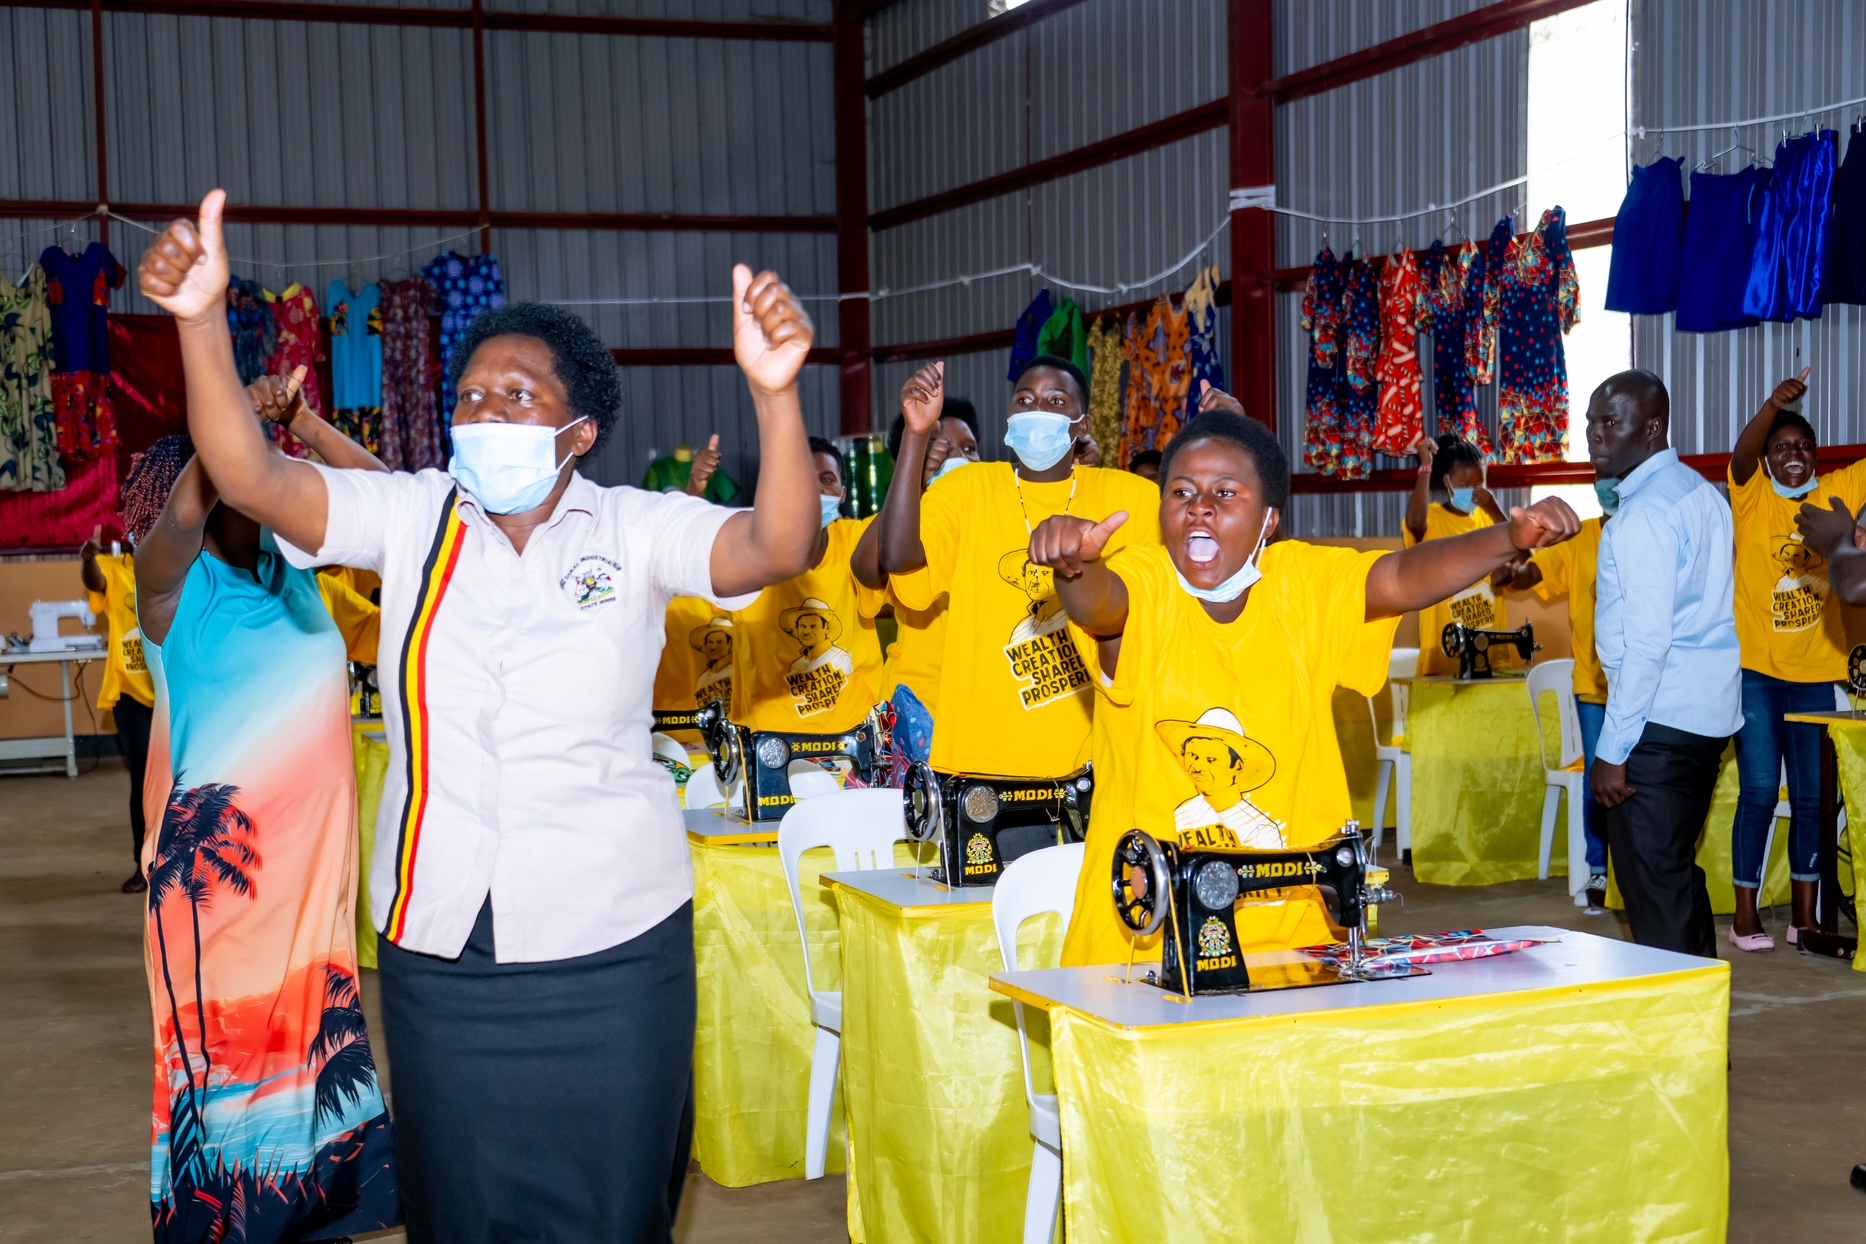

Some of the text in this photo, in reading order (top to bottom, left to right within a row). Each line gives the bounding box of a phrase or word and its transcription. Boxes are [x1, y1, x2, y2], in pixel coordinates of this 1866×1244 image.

[1773, 585, 1811, 601] WEALTH
[1450, 595, 1482, 610] WEALTH
[1462, 607, 1491, 623] SHARED
[1783, 603, 1820, 620] SHARED
[1006, 628, 1068, 662] WEALTH
[786, 664, 831, 686] WEALTH
[694, 678, 731, 700] WEALTH
[791, 671, 842, 696] CREATION
[662, 716, 690, 724] MODI
[801, 742, 836, 752] MODI
[759, 795, 795, 806] MODI
[1013, 789, 1053, 801] MODI
[965, 863, 998, 876] MODI
[1256, 862, 1303, 878] MODI
[1196, 955, 1237, 972] MODI
